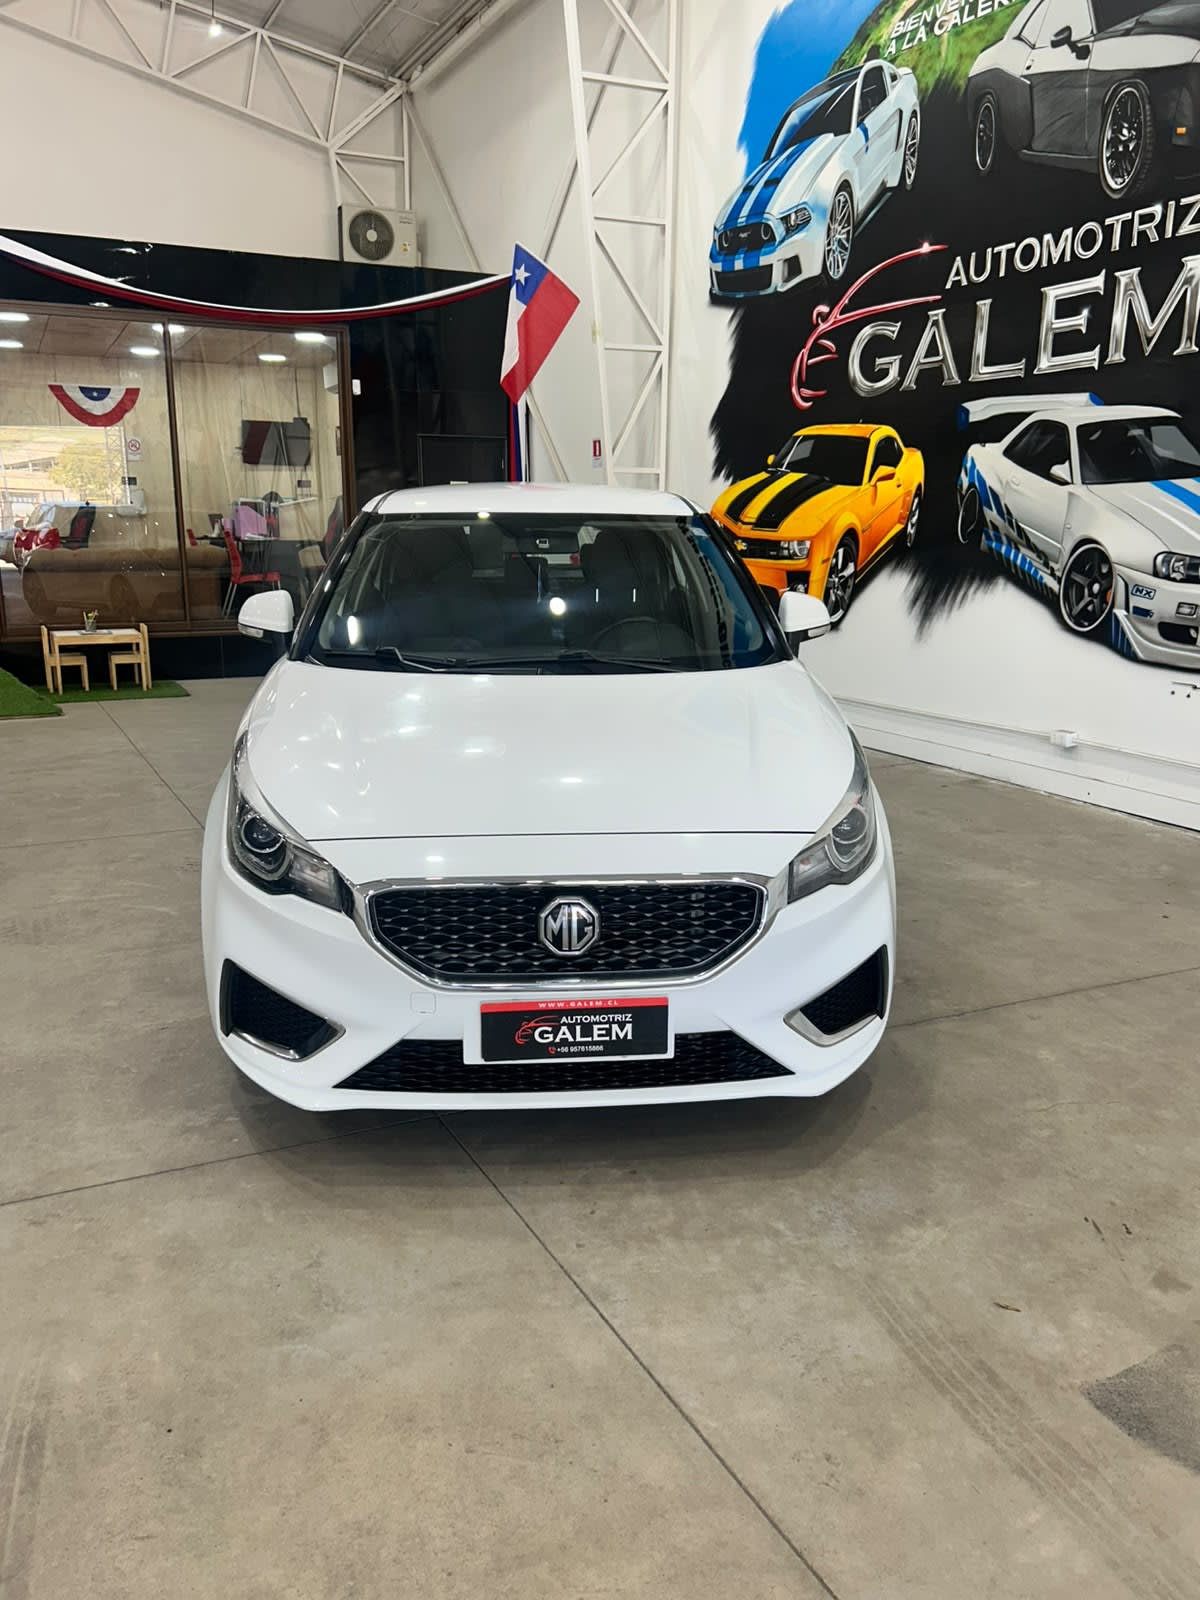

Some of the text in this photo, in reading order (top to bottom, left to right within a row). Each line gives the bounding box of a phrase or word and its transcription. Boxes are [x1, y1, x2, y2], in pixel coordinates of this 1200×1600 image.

[884, 38, 897, 58] A
[902, 25, 927, 51] LA
[944, 193, 1200, 290] AUTOMOTRIZ
[847, 253, 1200, 398] GALEM
[546, 904, 593, 950] MG
[533, 1023, 633, 1044] GALEM
[560, 1013, 632, 1024] AUTOMOTRIZ
